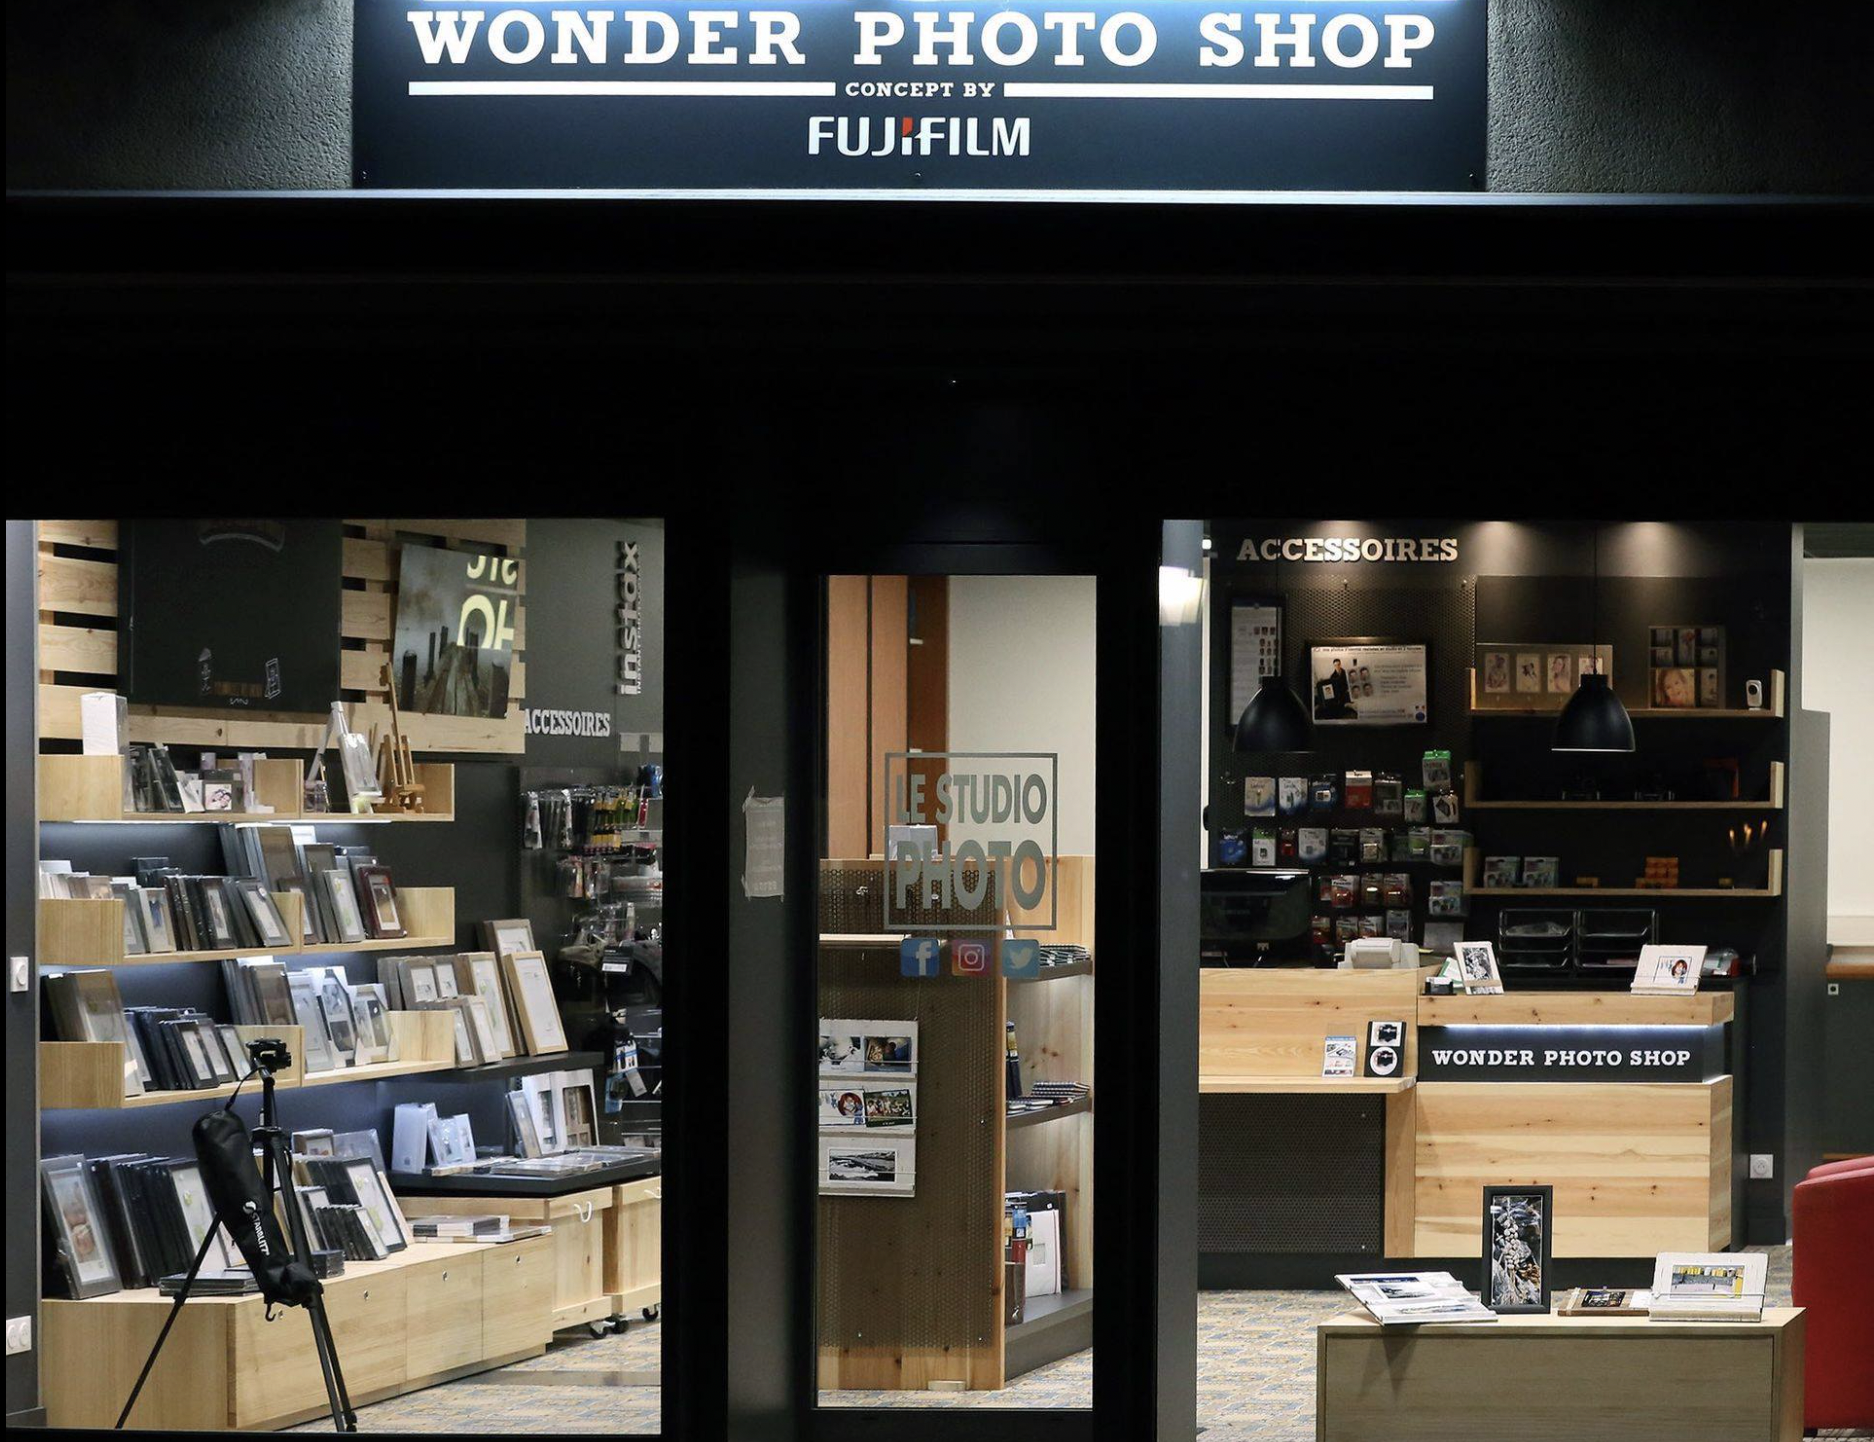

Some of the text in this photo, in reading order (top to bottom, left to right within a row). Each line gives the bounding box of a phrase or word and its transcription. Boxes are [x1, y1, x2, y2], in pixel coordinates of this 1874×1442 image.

[407, 9, 1435, 69] WONDER PHOTO SHOP
[845, 82, 996, 98] CONCEPT BY
[1236, 537, 1459, 562] ACCESSOIRES
[618, 541, 639, 695] instax
[524, 708, 611, 737] ACCESSOIRES
[896, 773, 1048, 826] LE STUDIO
[896, 839, 1047, 912] PHOTO
[1431, 1049, 1691, 1066] WONDER PHOTO SHOP
